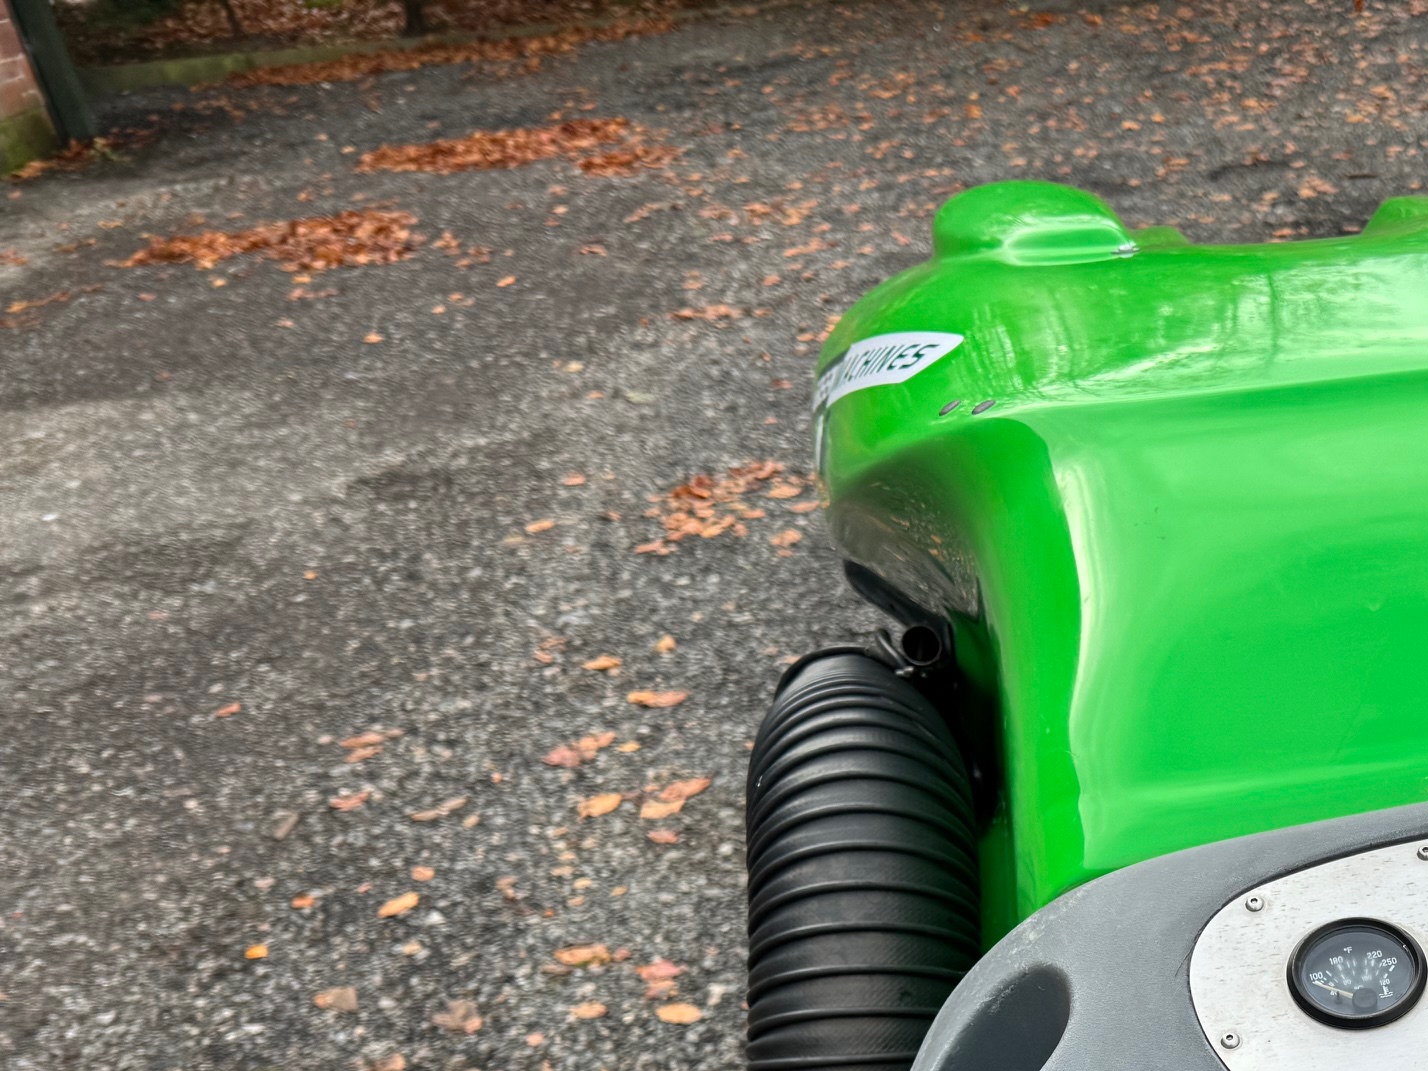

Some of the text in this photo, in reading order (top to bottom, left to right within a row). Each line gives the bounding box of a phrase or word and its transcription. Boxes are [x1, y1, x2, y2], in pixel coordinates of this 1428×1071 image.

[1366, 950, 1383, 960] 220
[1381, 957, 1398, 967] 250
[1309, 972, 1323, 981] 100
